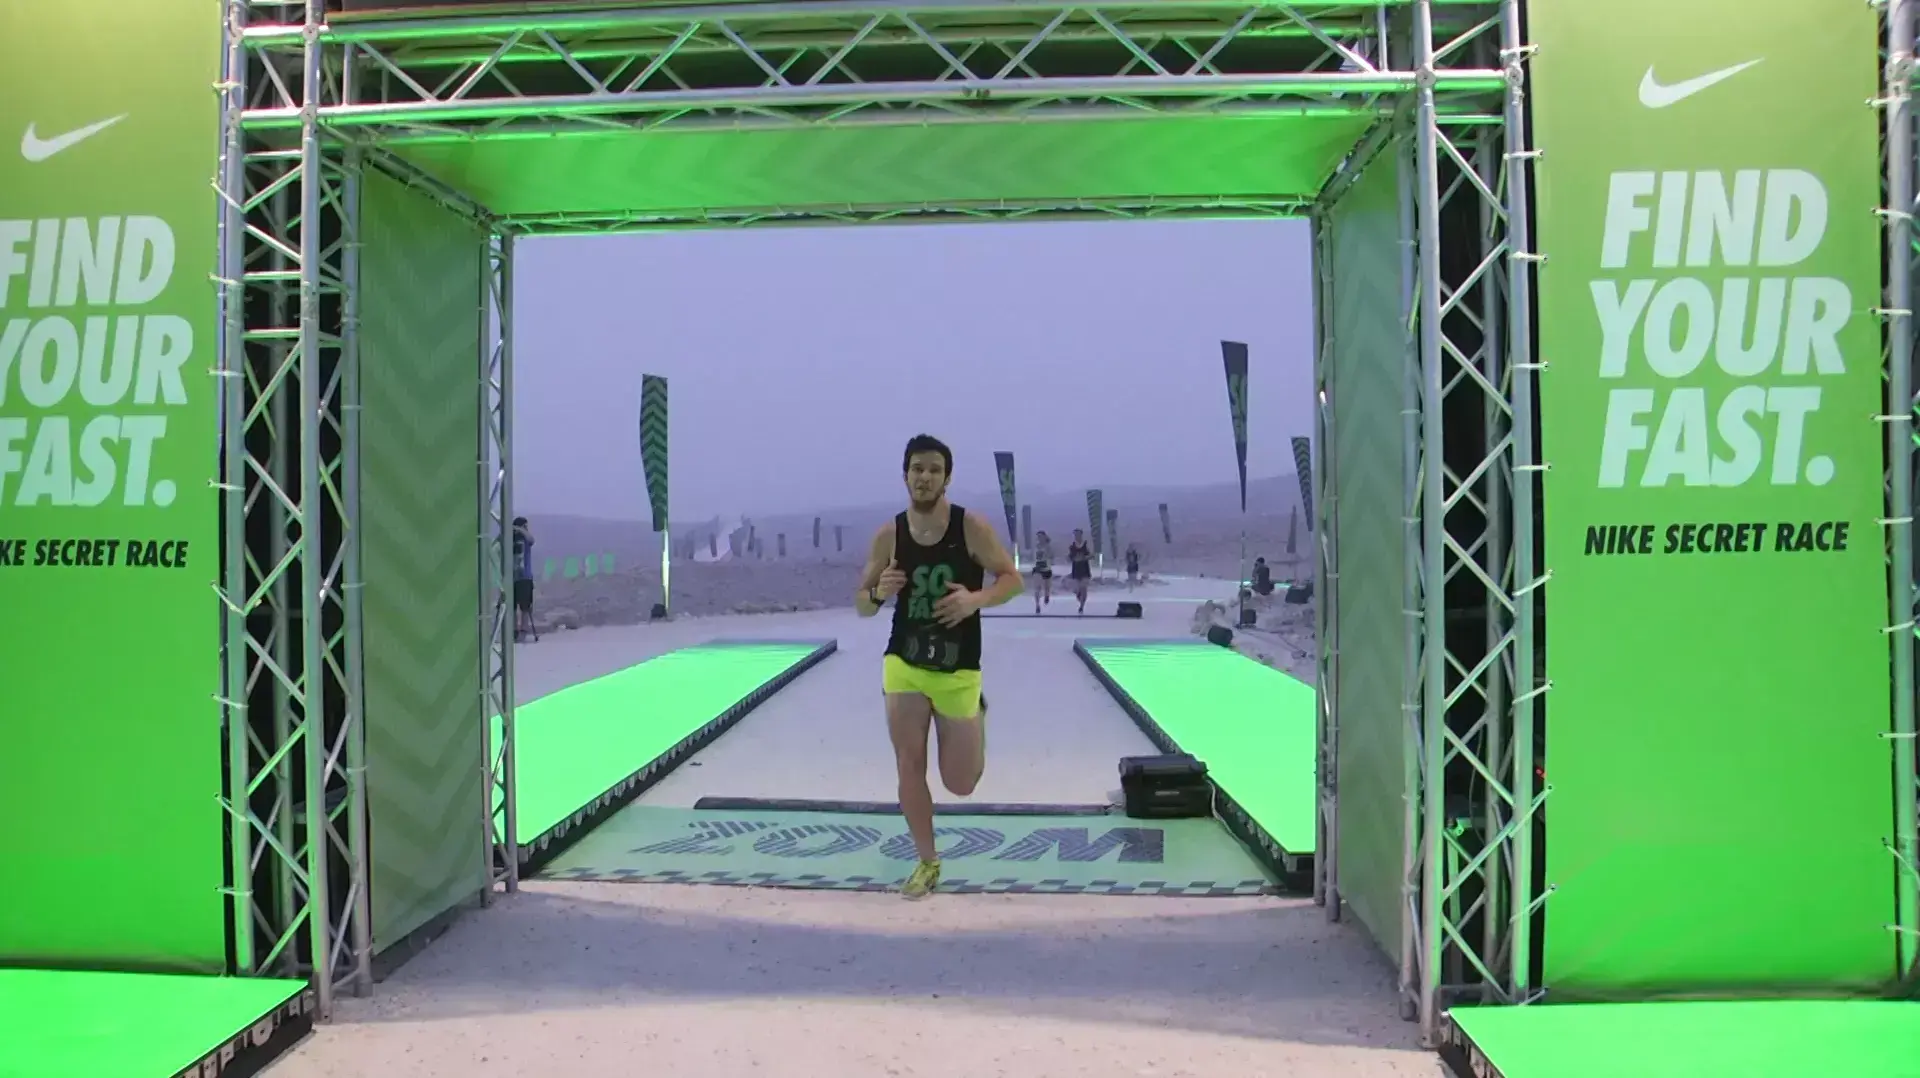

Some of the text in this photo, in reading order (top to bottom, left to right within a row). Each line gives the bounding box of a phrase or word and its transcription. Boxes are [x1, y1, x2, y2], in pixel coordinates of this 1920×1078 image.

[1600, 169, 1828, 268] FIND
[0, 215, 176, 308] FIND
[1589, 277, 1852, 378] YOUR
[1598, 385, 1835, 488] FAST.
[0, 539, 189, 568] KE SECRET RACE
[1584, 521, 1849, 555] NIKE SECRET RACE
[912, 564, 953, 598] SO
[628, 820, 1165, 864] ZOOM
